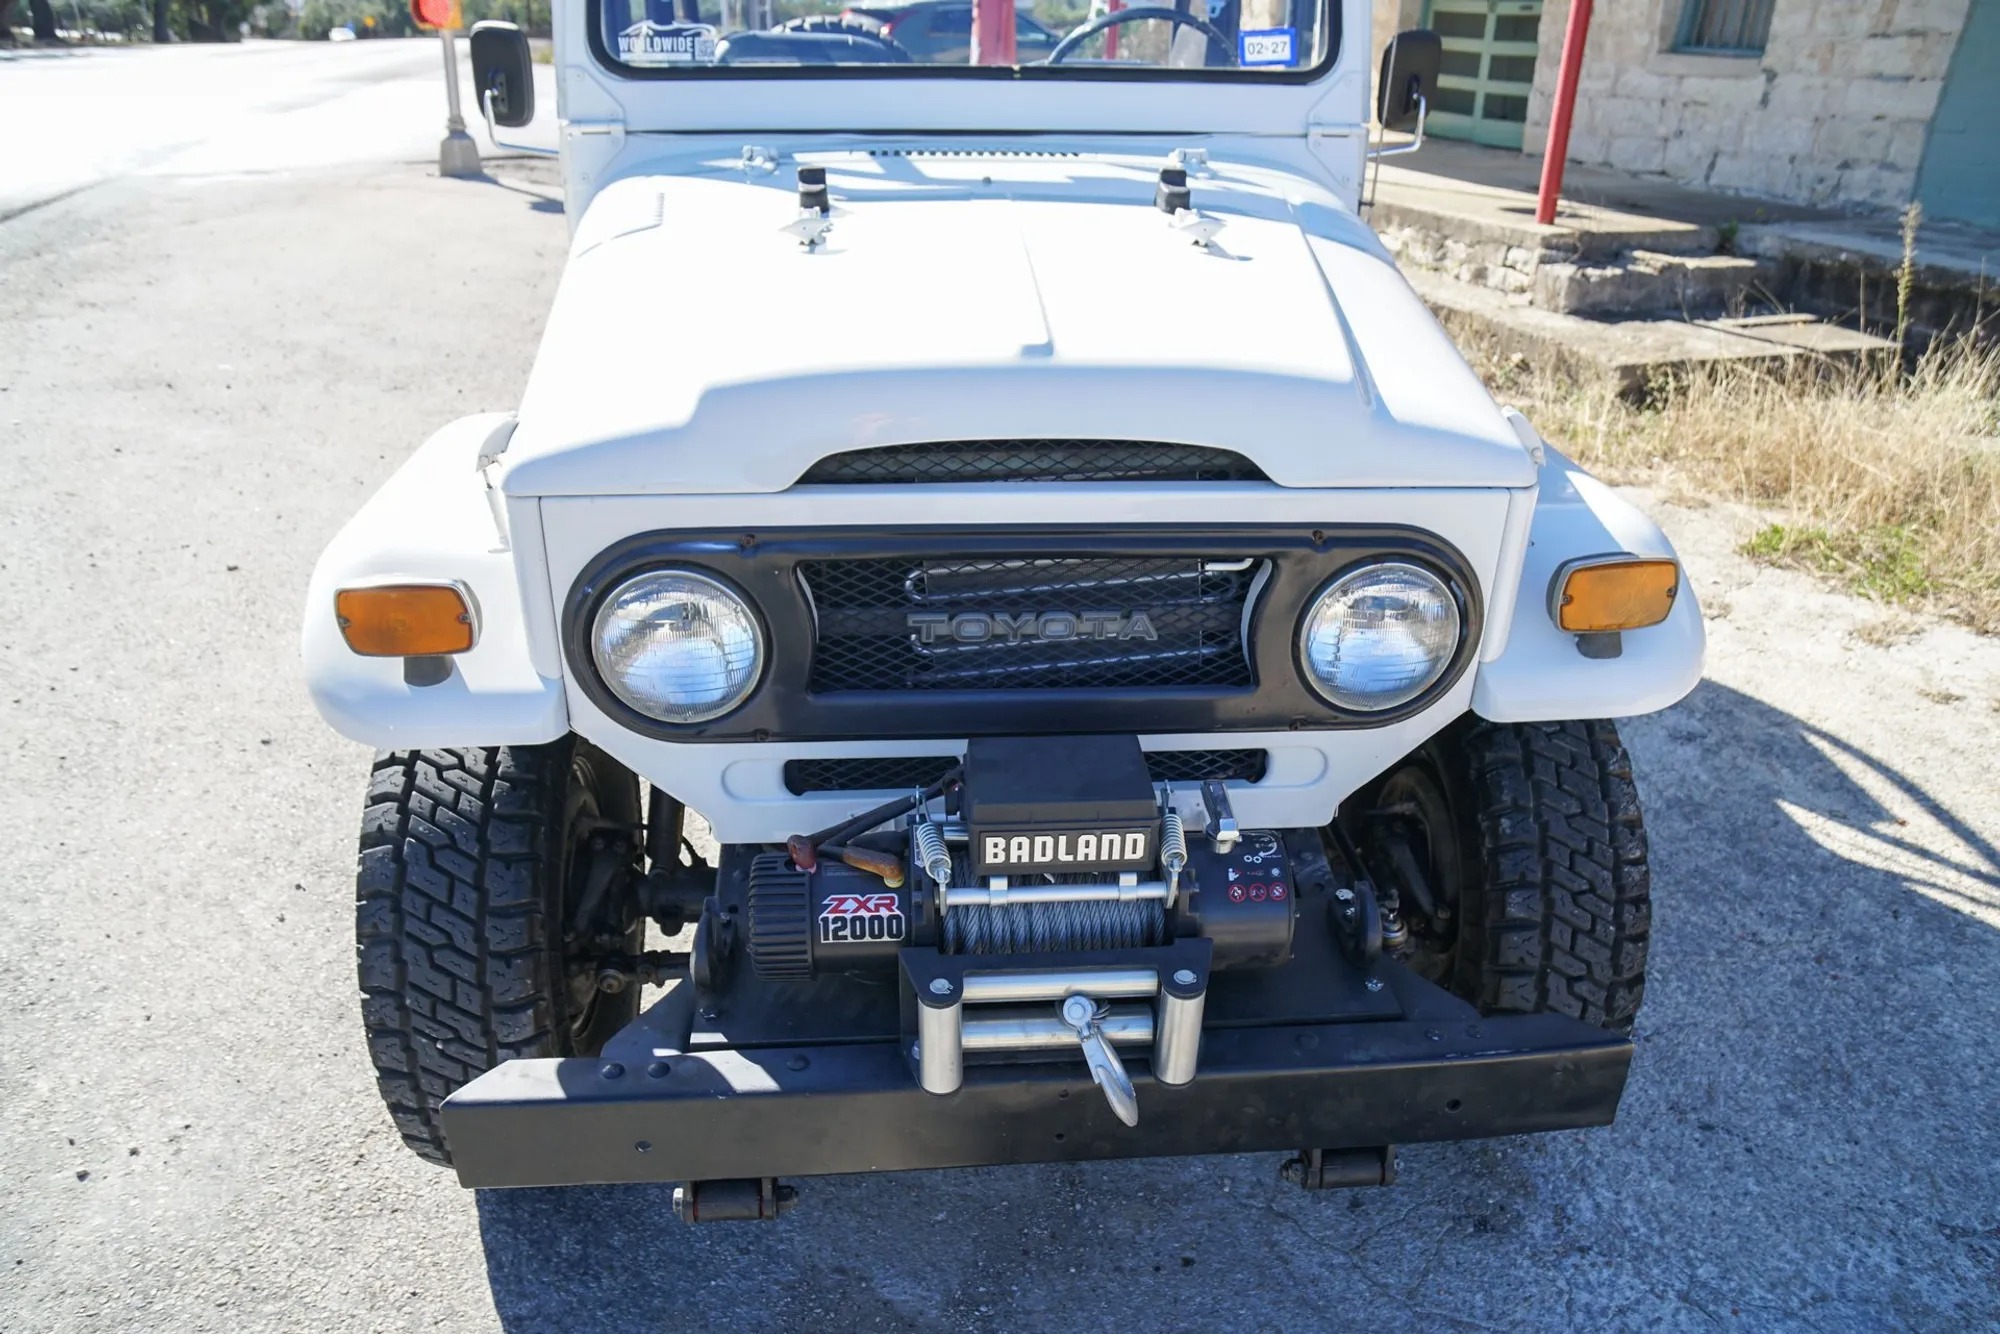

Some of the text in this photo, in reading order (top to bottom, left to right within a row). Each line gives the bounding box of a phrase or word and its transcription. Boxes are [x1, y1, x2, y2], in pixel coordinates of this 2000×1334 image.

[907, 611, 1158, 643] TOYOTA
[985, 833, 1145, 864] BADLAND
[823, 894, 898, 915] ZXR
[820, 914, 904, 942] 12000
